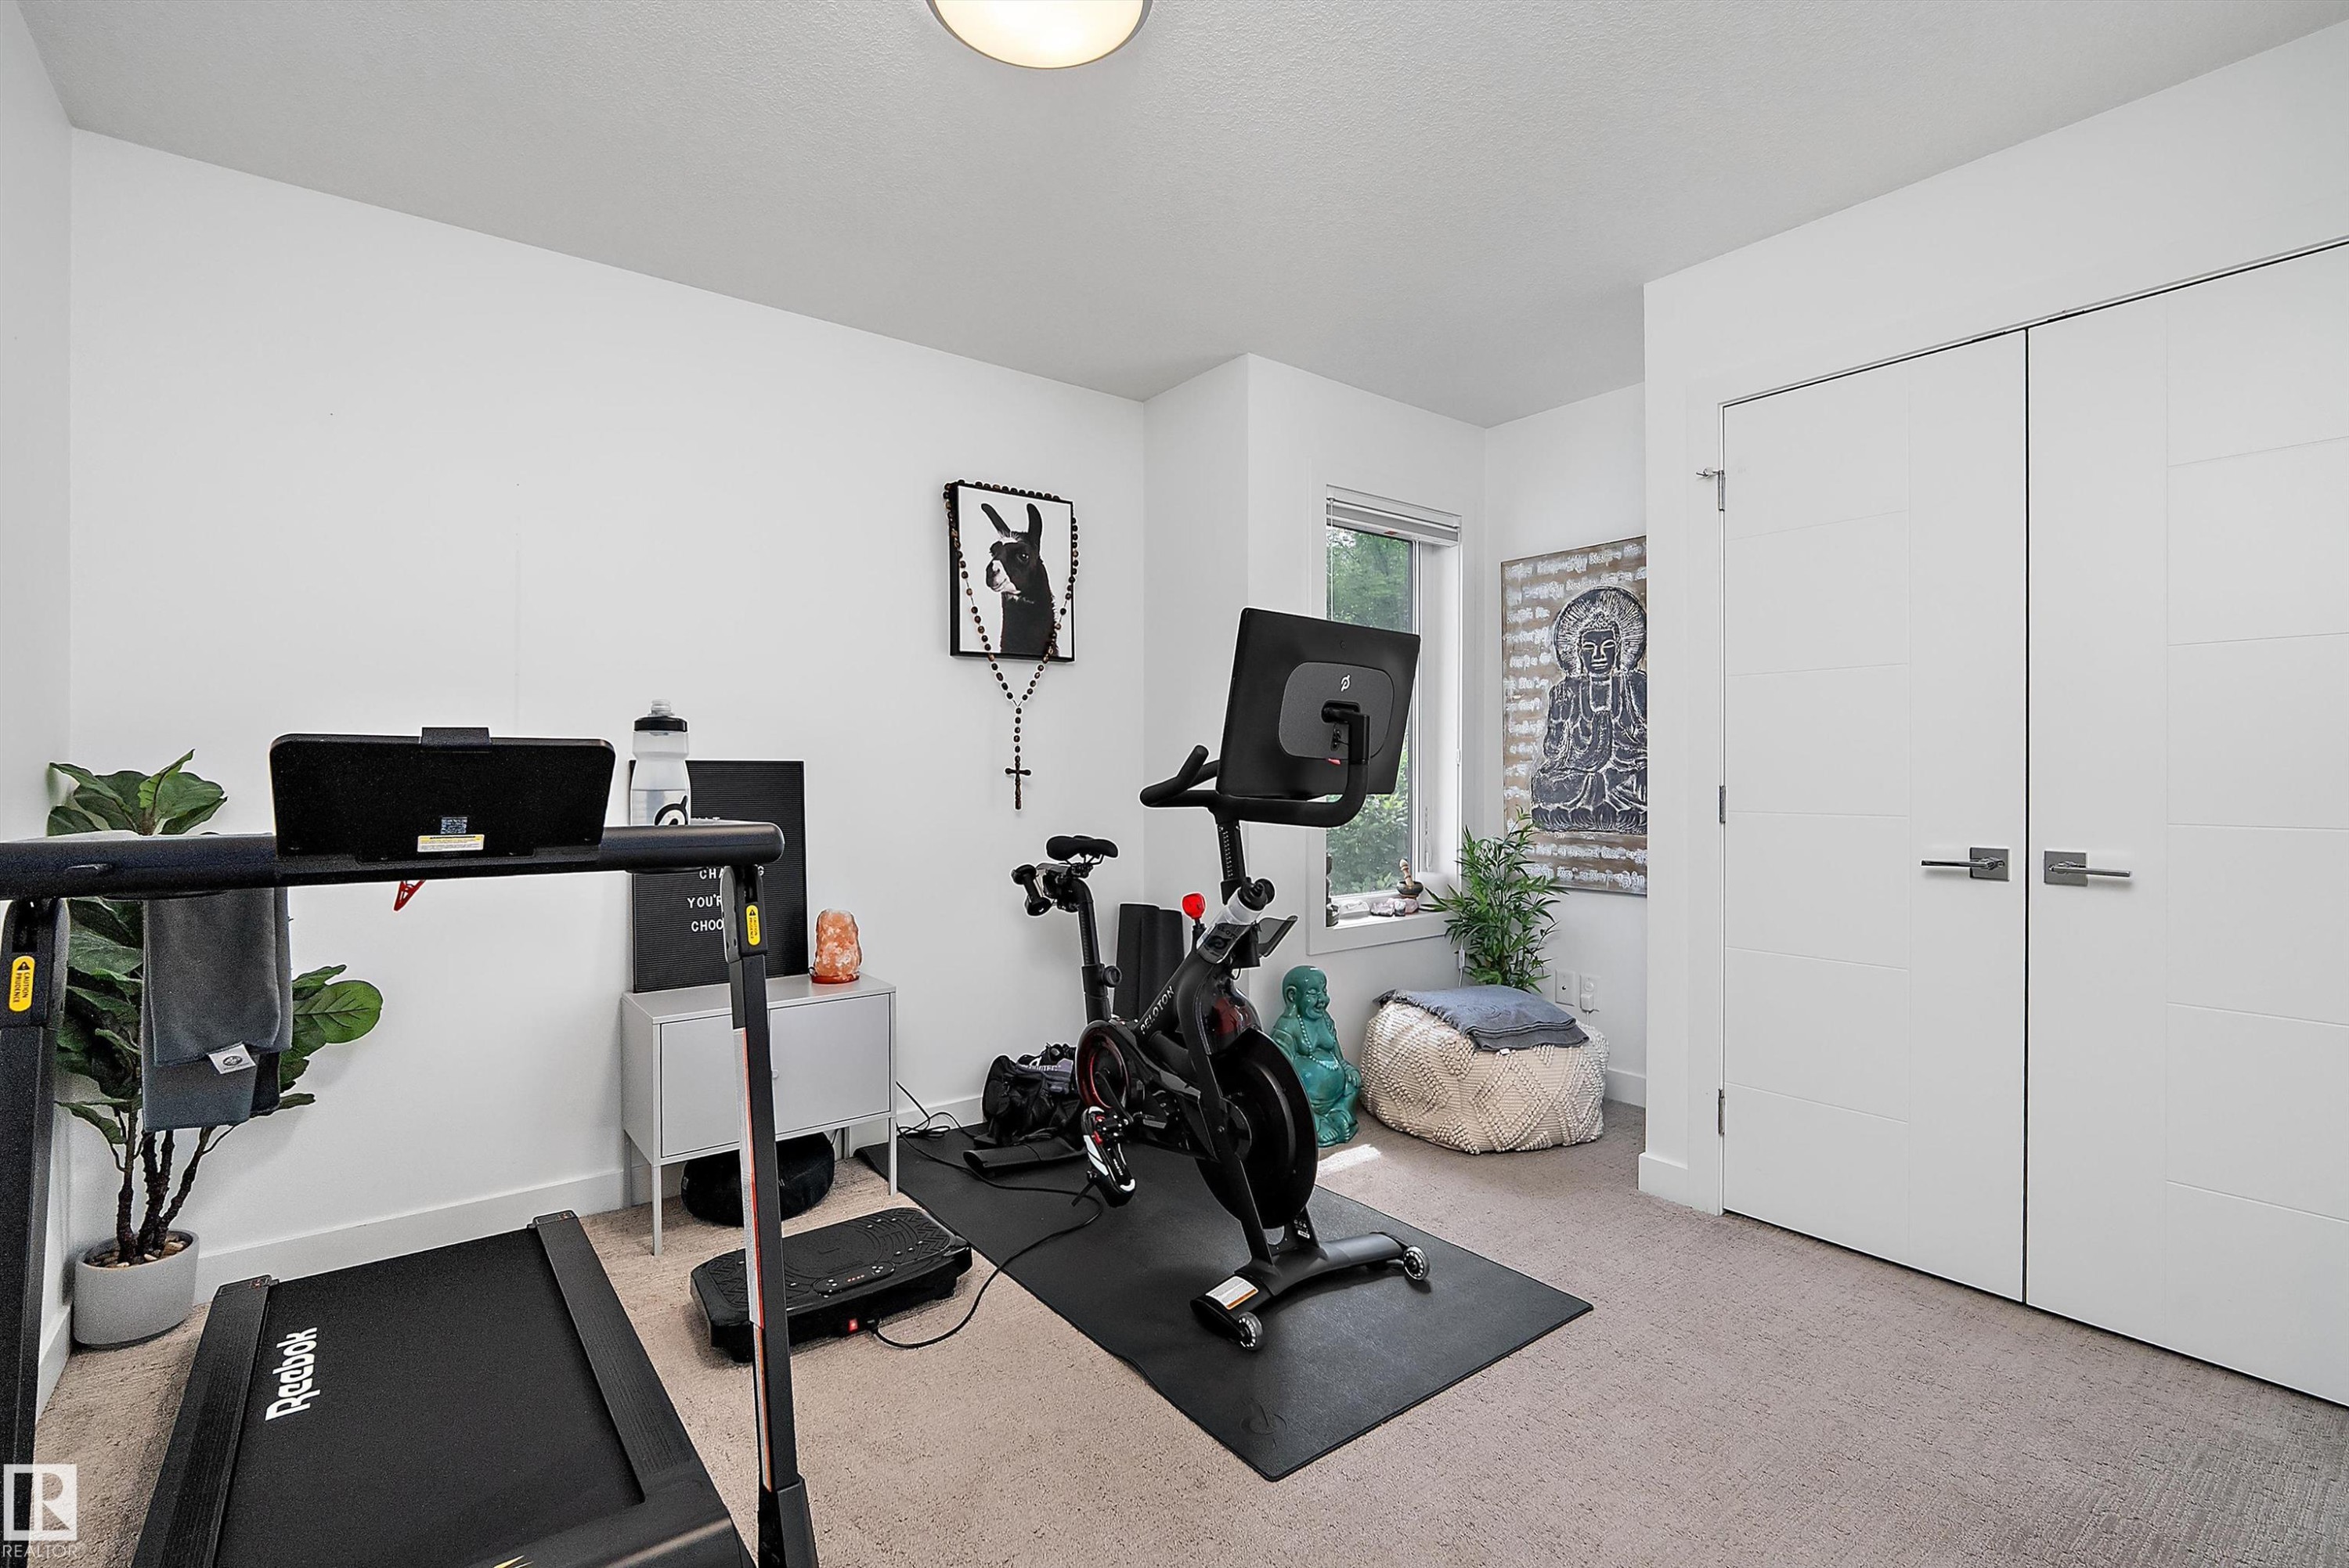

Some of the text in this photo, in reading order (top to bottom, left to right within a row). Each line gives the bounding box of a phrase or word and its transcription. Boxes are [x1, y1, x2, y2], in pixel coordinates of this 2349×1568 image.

[687, 893, 722, 908] YOU'R
[691, 918, 724, 932] CHOO
[1140, 986, 1174, 1035] PELOTON
[265, 1327, 321, 1422] Reebok
